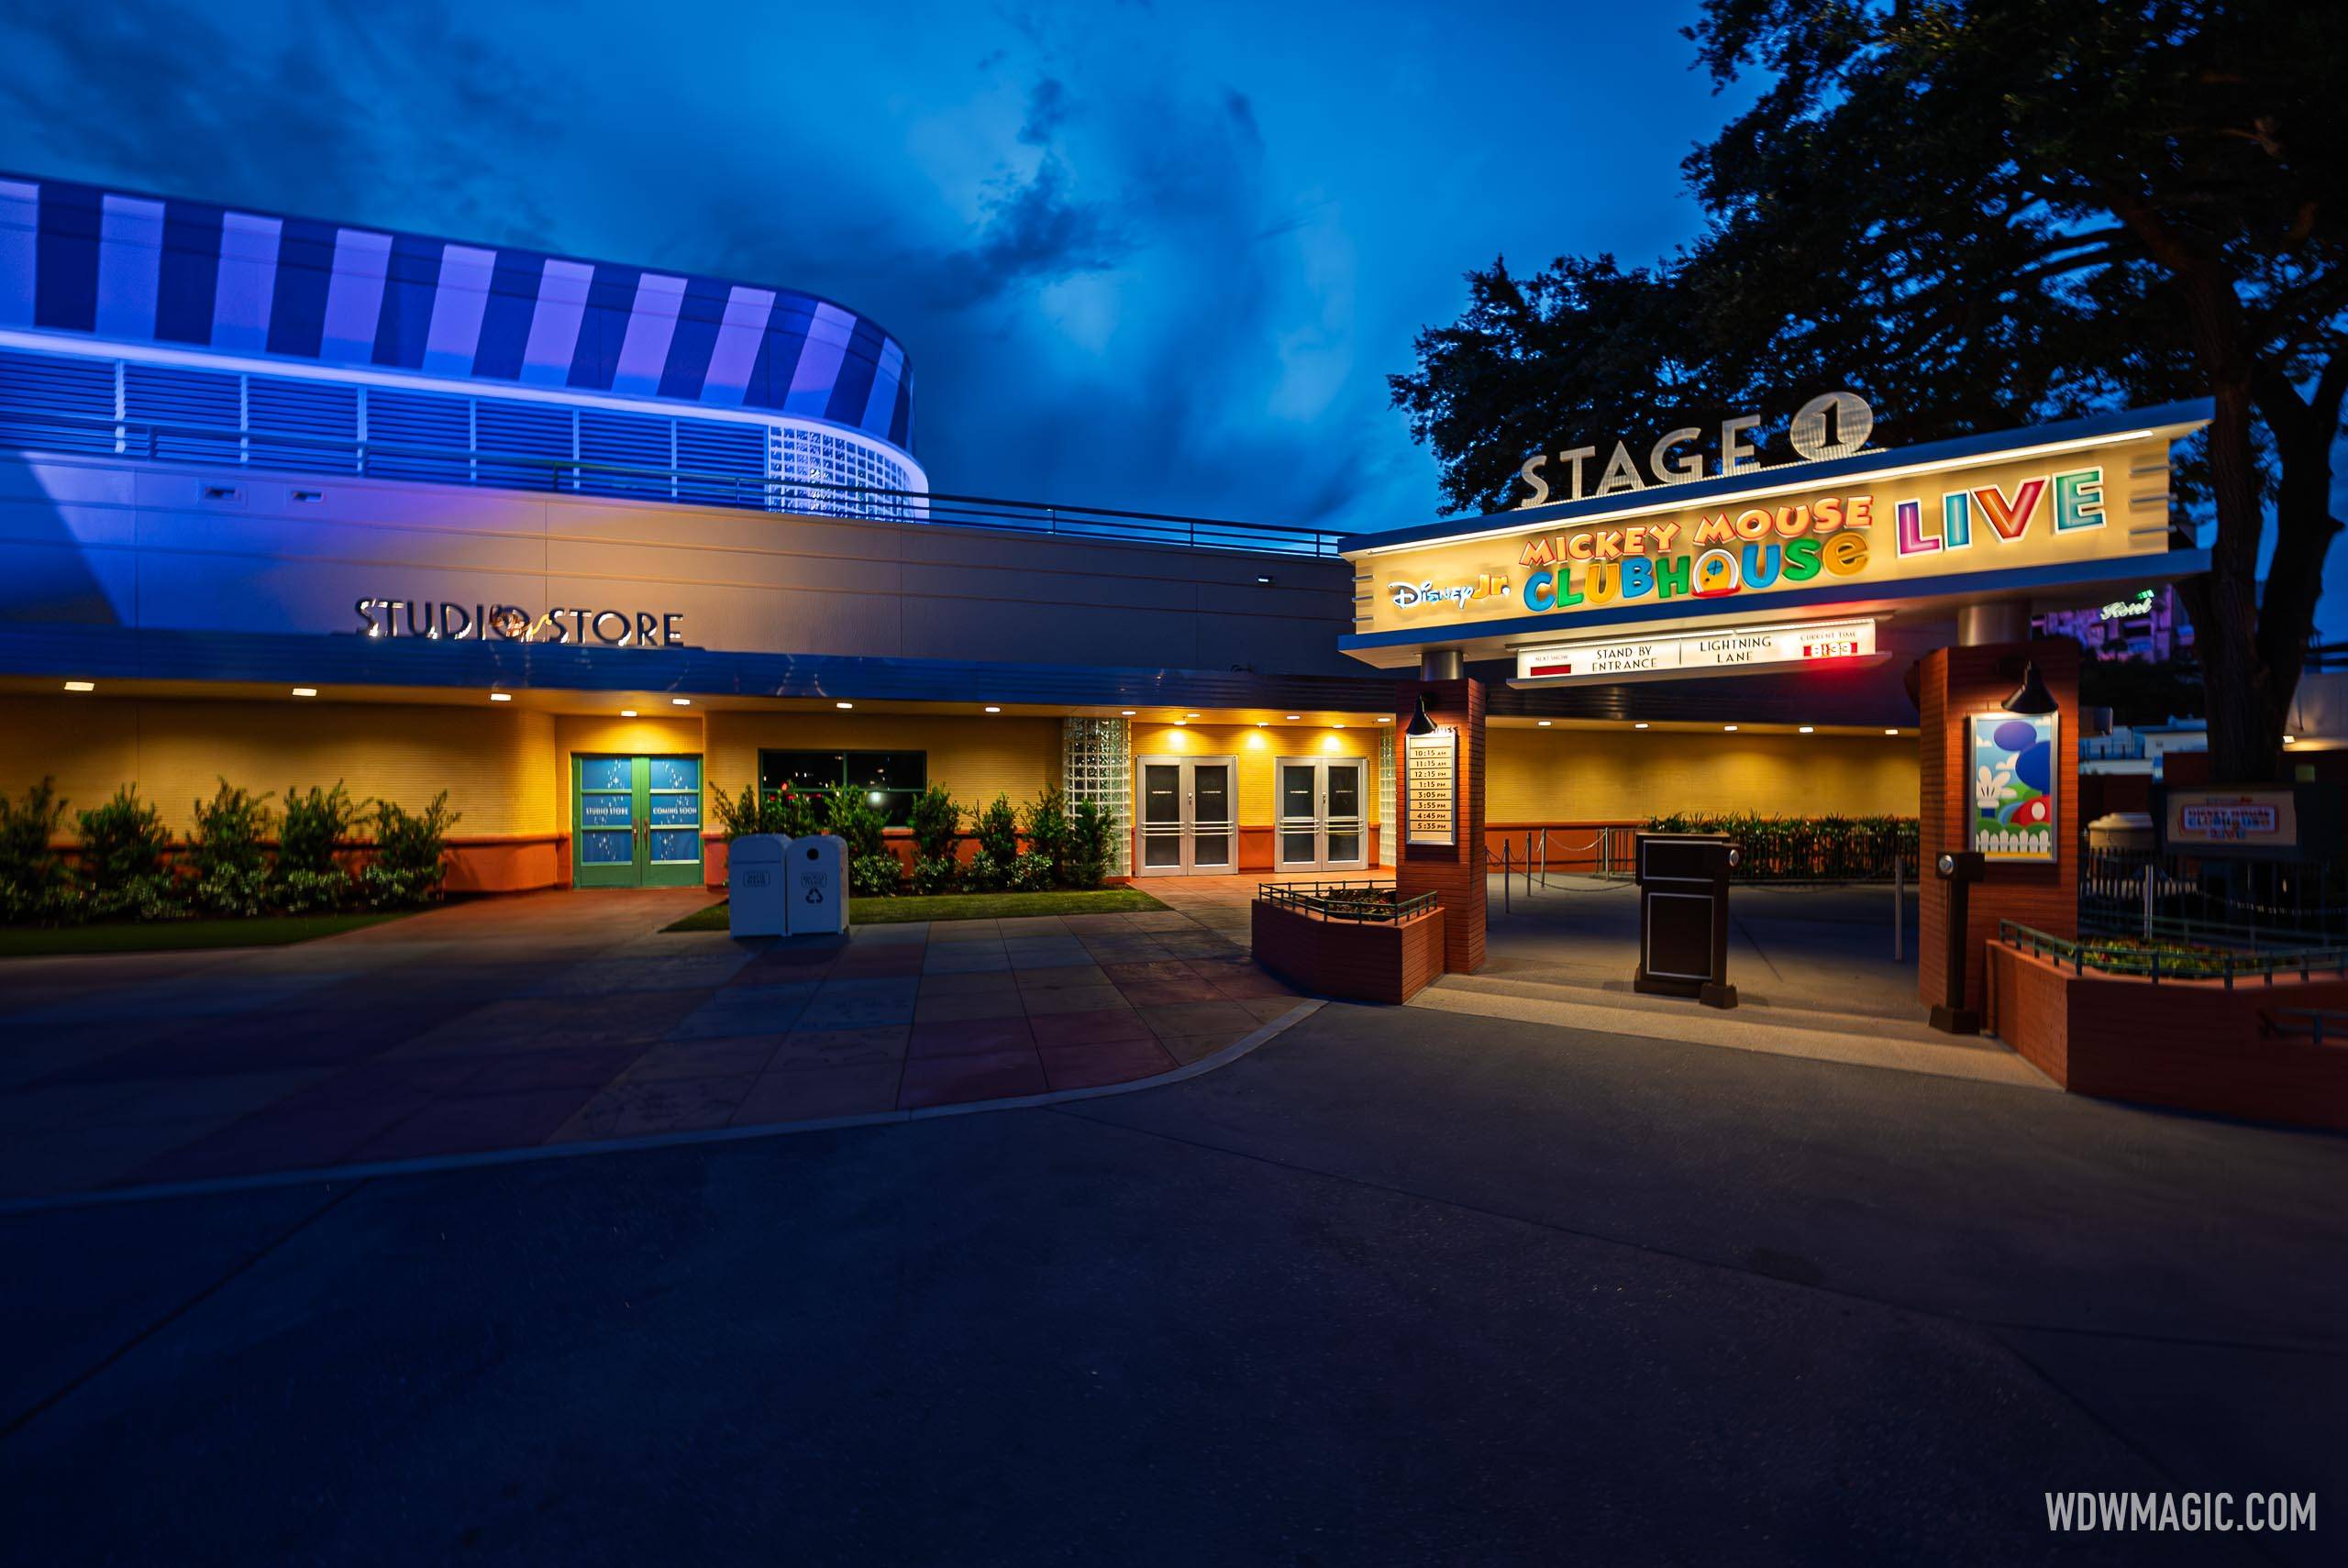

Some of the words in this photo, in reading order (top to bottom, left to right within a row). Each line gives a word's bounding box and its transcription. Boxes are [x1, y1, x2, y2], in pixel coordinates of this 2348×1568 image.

[1520, 414, 1761, 508] STAGE
[1894, 466, 2107, 558] LIVE
[1519, 520, 1681, 568] MICKEY
[1693, 495, 1874, 547] MOUSE
[1471, 572, 1511, 600] Jr.
[1523, 532, 1869, 613] CLUBHOUSE
[355, 597, 531, 642] STUDIO
[548, 607, 684, 646] STORE
[1597, 647, 1633, 660] STAND
[1638, 646, 1652, 657] BY
[1700, 636, 1772, 652] LIGHTNING
[1717, 651, 1753, 664] LANE
[1592, 657, 1658, 672] ENTRANCE
[653, 807, 677, 815] COMING
